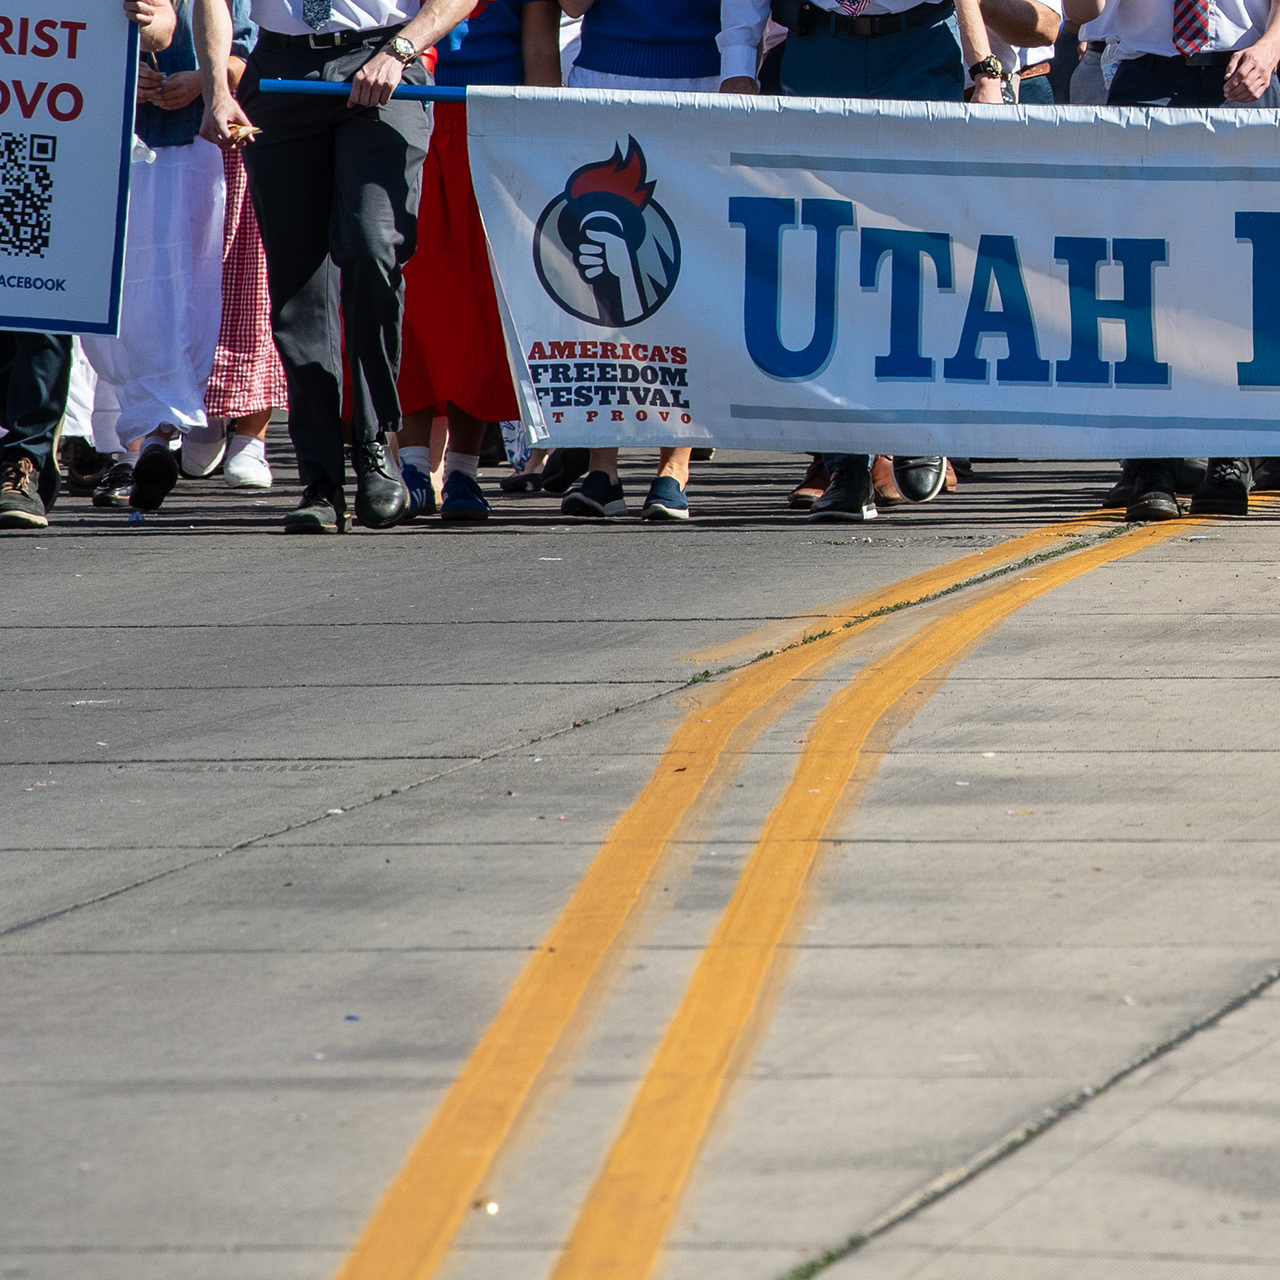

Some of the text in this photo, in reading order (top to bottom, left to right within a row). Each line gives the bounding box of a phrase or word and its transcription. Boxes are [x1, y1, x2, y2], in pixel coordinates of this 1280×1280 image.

[0, 80, 84, 122] VO
[728, 197, 1171, 389] UTAH
[528, 341, 687, 365] AMERICA'S
[528, 362, 689, 387] FREEDOM
[537, 385, 690, 409] FESTIVAL
[552, 410, 692, 424] T PROVO
